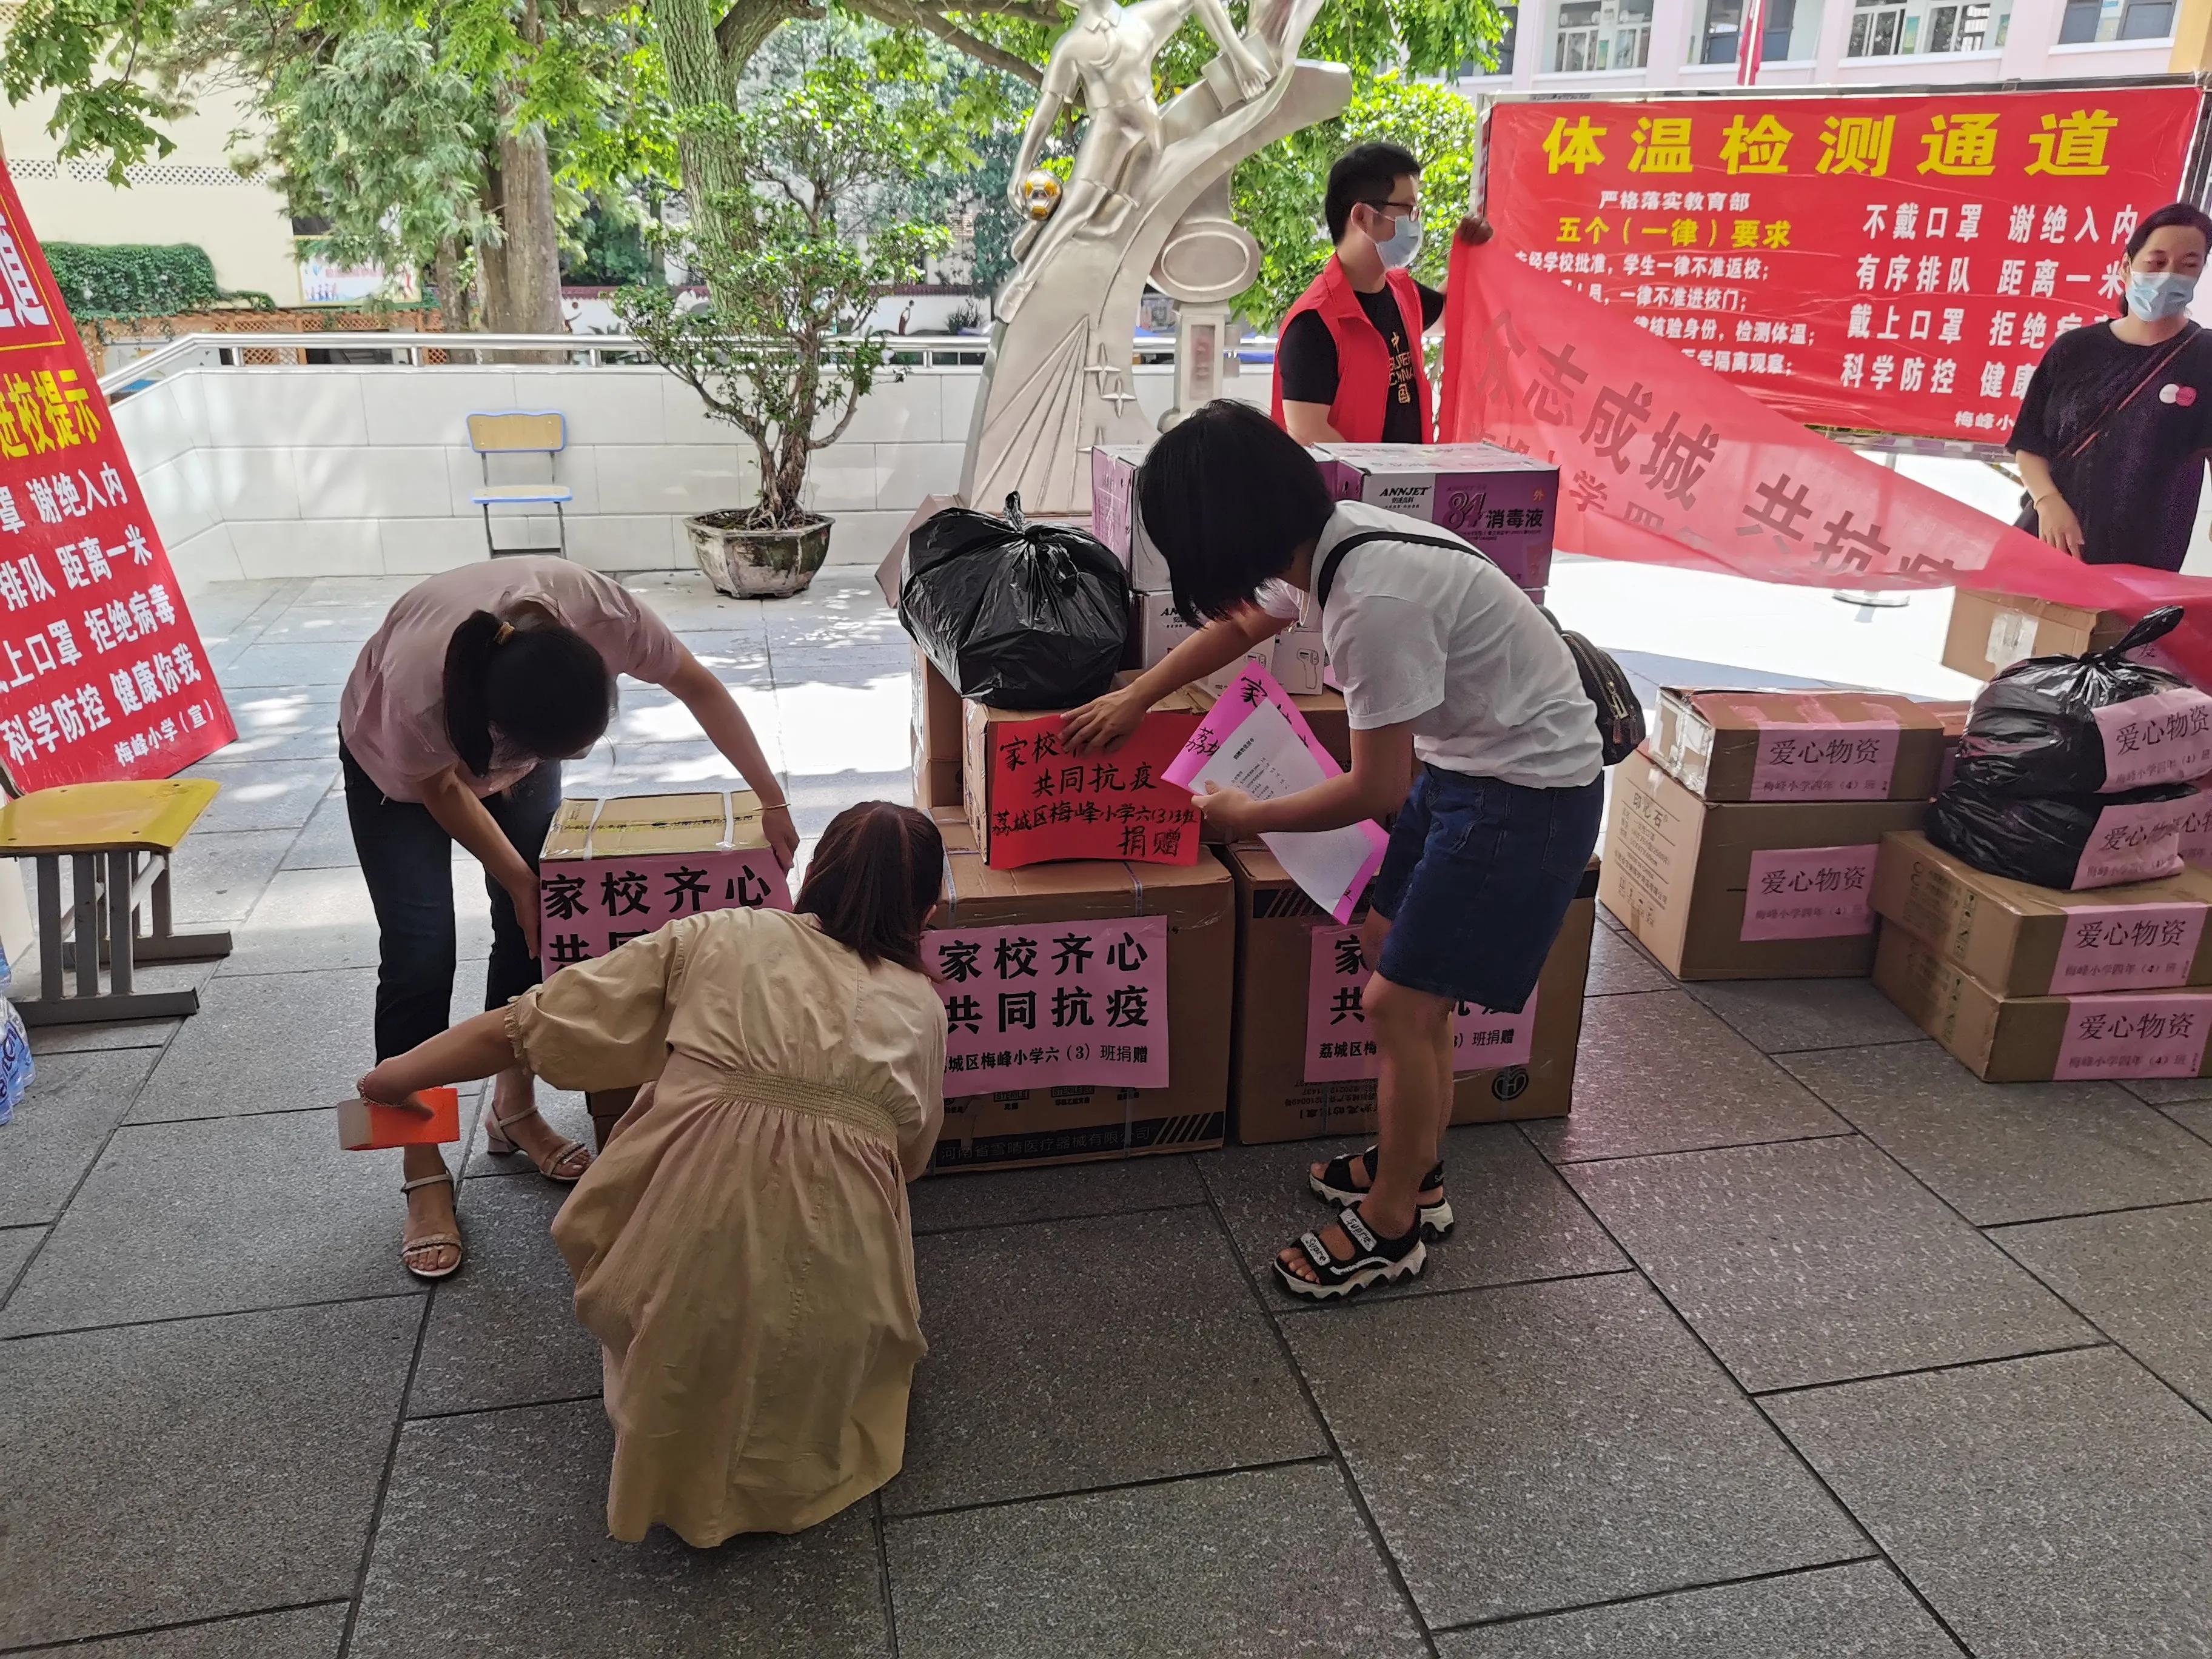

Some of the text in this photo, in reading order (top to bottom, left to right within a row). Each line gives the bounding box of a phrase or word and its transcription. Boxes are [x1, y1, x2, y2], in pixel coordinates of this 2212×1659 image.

[1542, 109, 2119, 176] 体温检测通道
[1598, 190, 1751, 212] 严格落实教育部
[1556, 216, 1791, 249] 五个（一律）要求
[1863, 203, 2138, 244] 不戴口罩 谢绝入内
[1855, 253, 2123, 300] 有序排队 距离一米
[1846, 304, 2111, 349] 戴上口罩 拒绝病
[1840, 353, 1958, 394] 科学防控
[25, 461, 129, 525] 谢绝入内
[1379, 486, 1432, 497] ANNJET
[1486, 508, 1544, 529] 消毒液
[55, 523, 153, 591] 距离一米
[0, 583, 176, 694] 上口罩 拒绝病毒
[2, 642, 202, 766] 科学防控 健康你我
[113, 699, 215, 768] 梅峰小学（宣）
[1769, 737, 1880, 765] 爱心物资
[2116, 705, 2210, 756] 爱心物资
[1000, 731, 1078, 772] 家校
[1031, 761, 1158, 798] 共同抗疫
[1116, 825, 1181, 857] 捐赠
[541, 864, 772, 920] 家校齐心
[1761, 866, 1866, 895] 爱心物资
[2075, 919, 2187, 948] 爱心物资
[938, 931, 1148, 984] 家校齐心
[944, 984, 1149, 1035] 共同抗疫
[2077, 1011, 2195, 1040] 爱心物资
[943, 1043, 1148, 1073] 城区梅峰小学六（3）班捐赠
